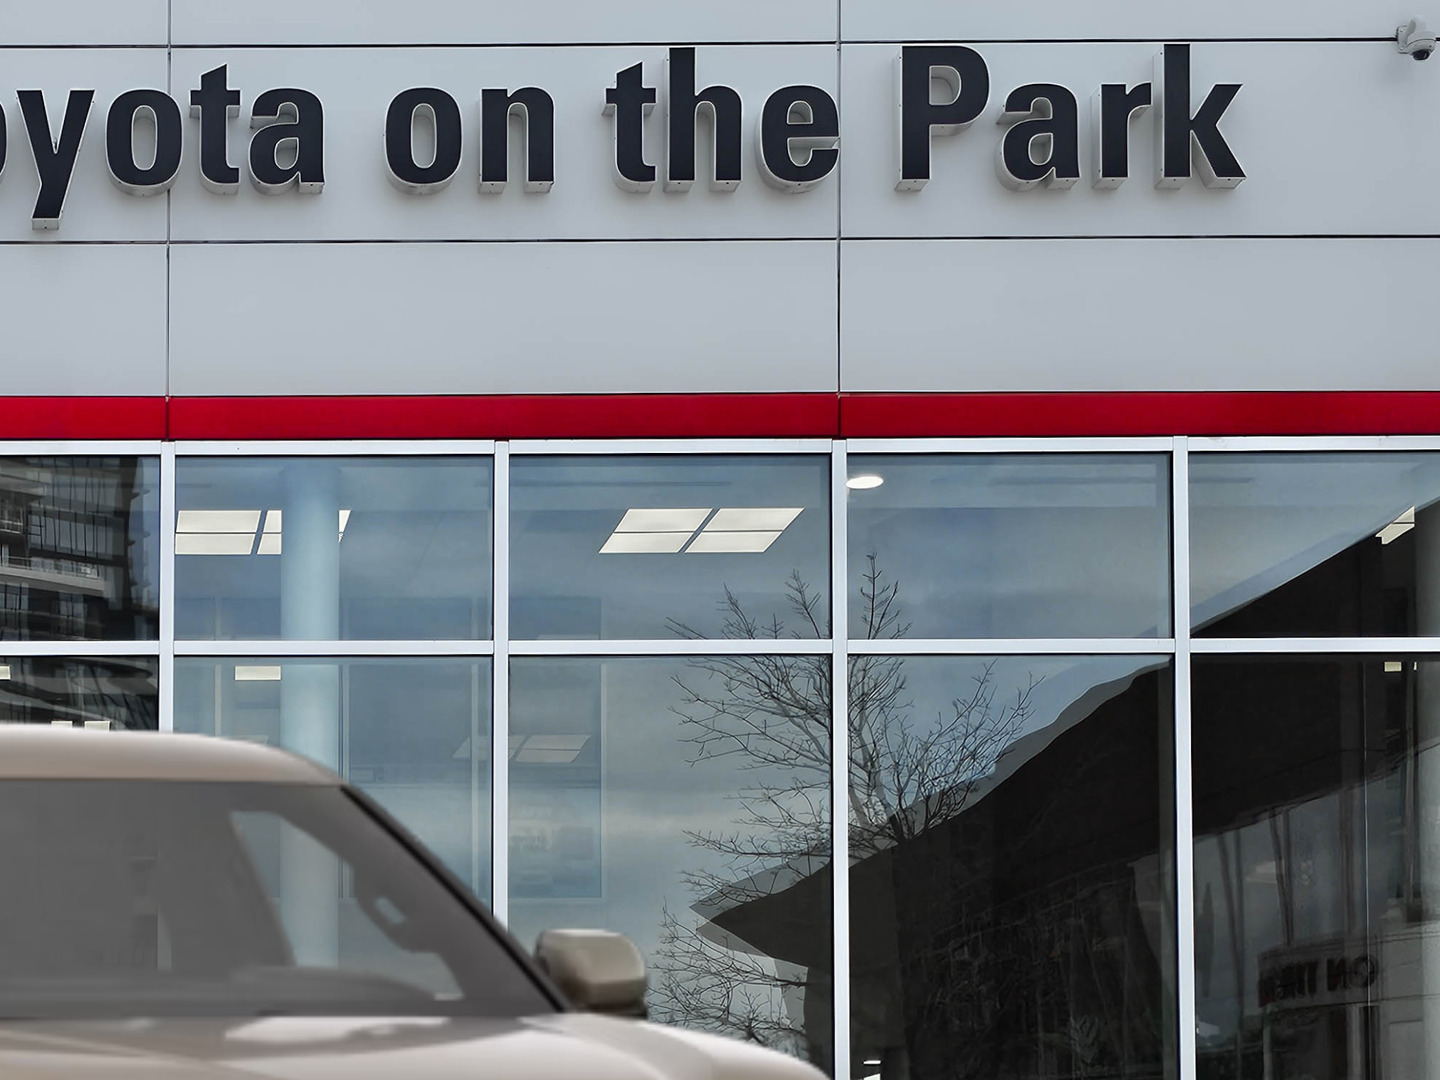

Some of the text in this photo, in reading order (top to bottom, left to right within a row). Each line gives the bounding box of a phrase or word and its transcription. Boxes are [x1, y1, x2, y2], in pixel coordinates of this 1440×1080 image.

[384, 86, 555, 194] on
[601, 46, 840, 194] the
[894, 43, 1247, 191] Park
